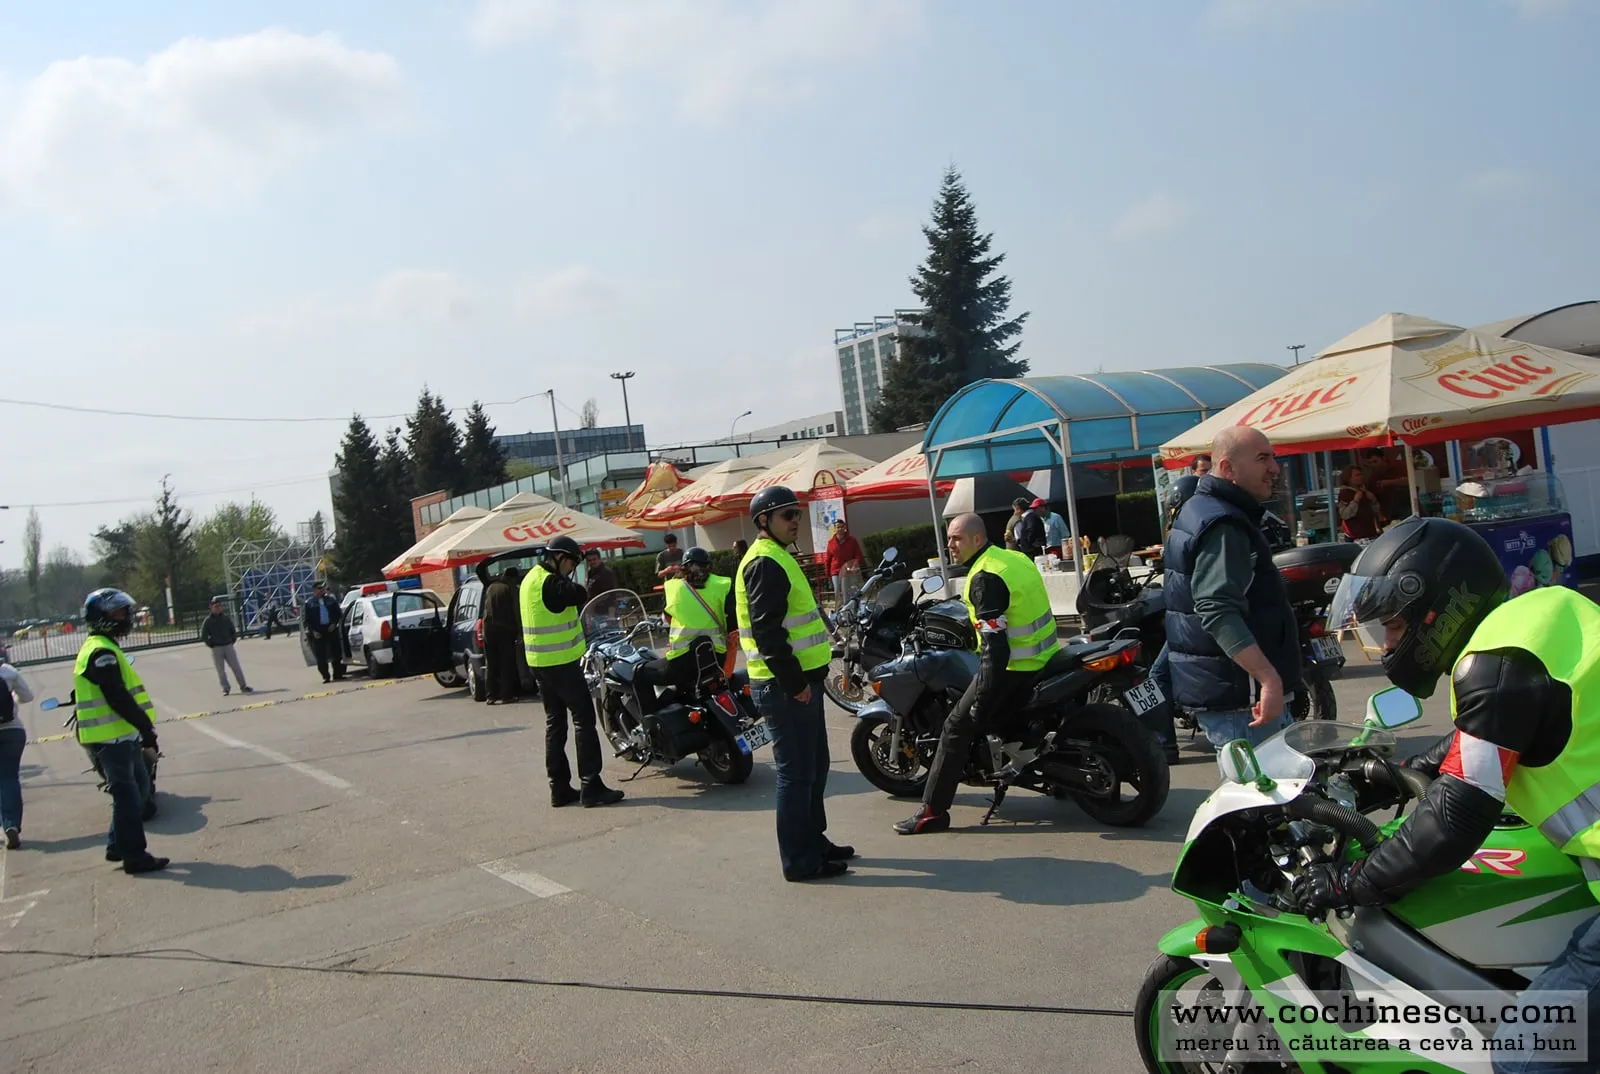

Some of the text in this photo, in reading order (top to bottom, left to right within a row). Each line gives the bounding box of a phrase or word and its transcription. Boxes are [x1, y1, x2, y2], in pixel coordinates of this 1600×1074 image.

[1437, 354, 1553, 399] Ciuc
[1236, 376, 1358, 427] Ciuc
[1346, 424, 1370, 437] Ciuc
[1402, 416, 1428, 432] Ciuc
[503, 517, 577, 542] Ciuc
[1129, 687, 1142, 701] NT
[1137, 692, 1159, 711] DUB
